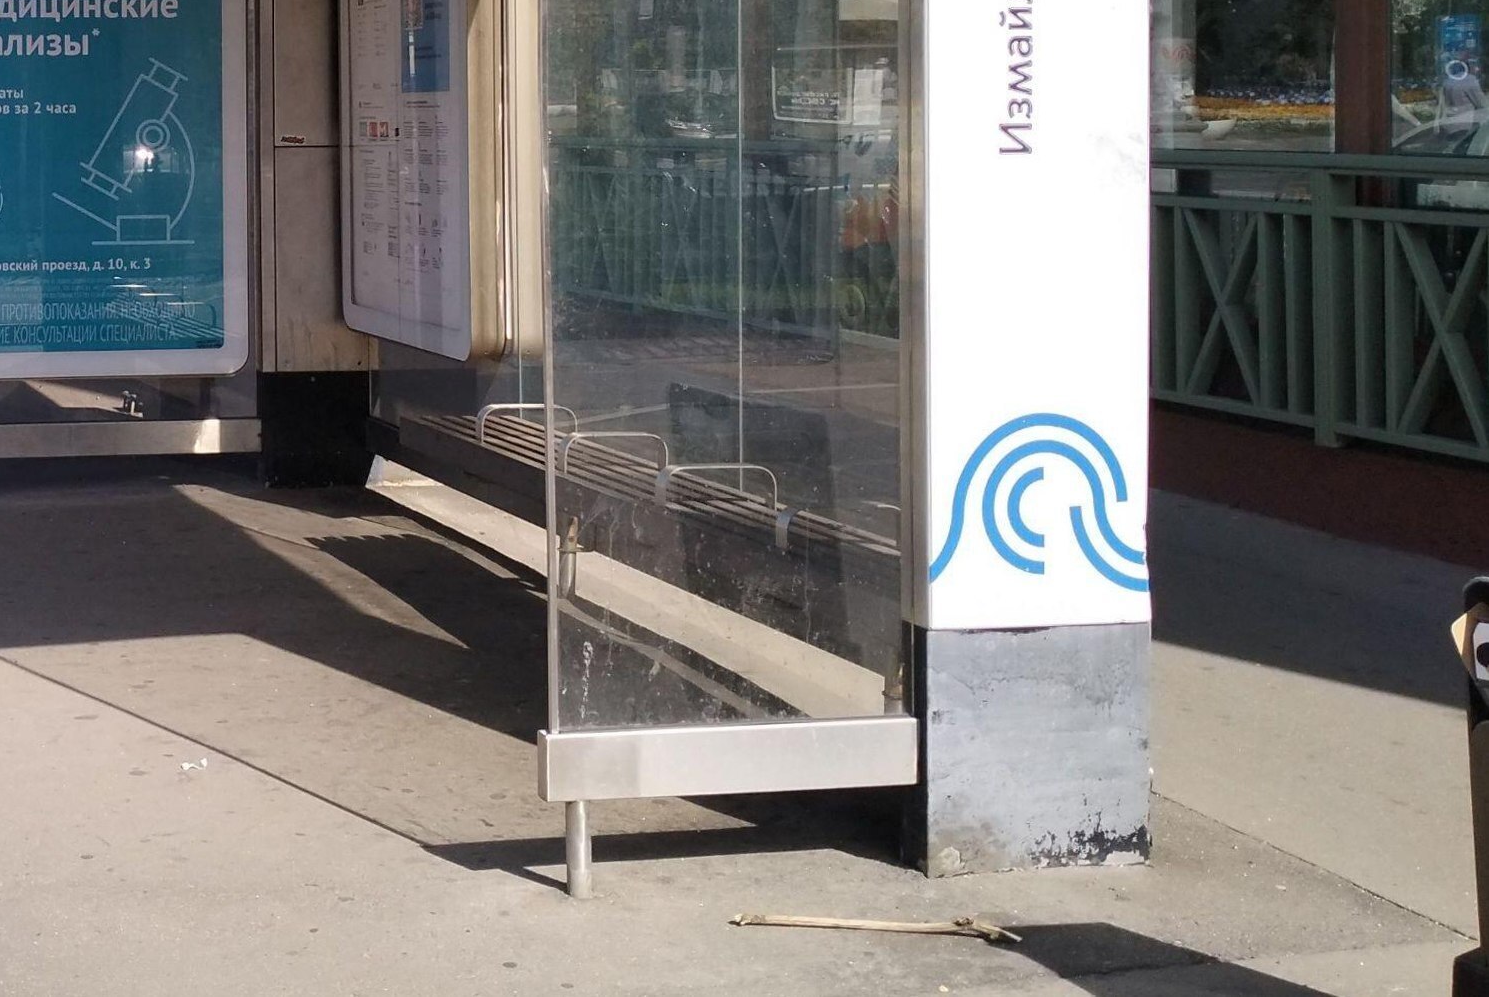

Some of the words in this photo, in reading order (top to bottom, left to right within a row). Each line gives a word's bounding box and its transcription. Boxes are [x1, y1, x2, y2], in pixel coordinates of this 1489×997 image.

[14, 103, 29, 115] за
[33, 101, 42, 114] 2
[46, 102, 77, 114] часа
[41, 260, 90, 273] проезд,
[92, 260, 106, 272] д.
[108, 258, 128, 271] 10,
[130, 260, 141, 270] к.
[143, 257, 151, 270] 3
[13, 324, 97, 345] КОНСУЛЬТАЦИИ
